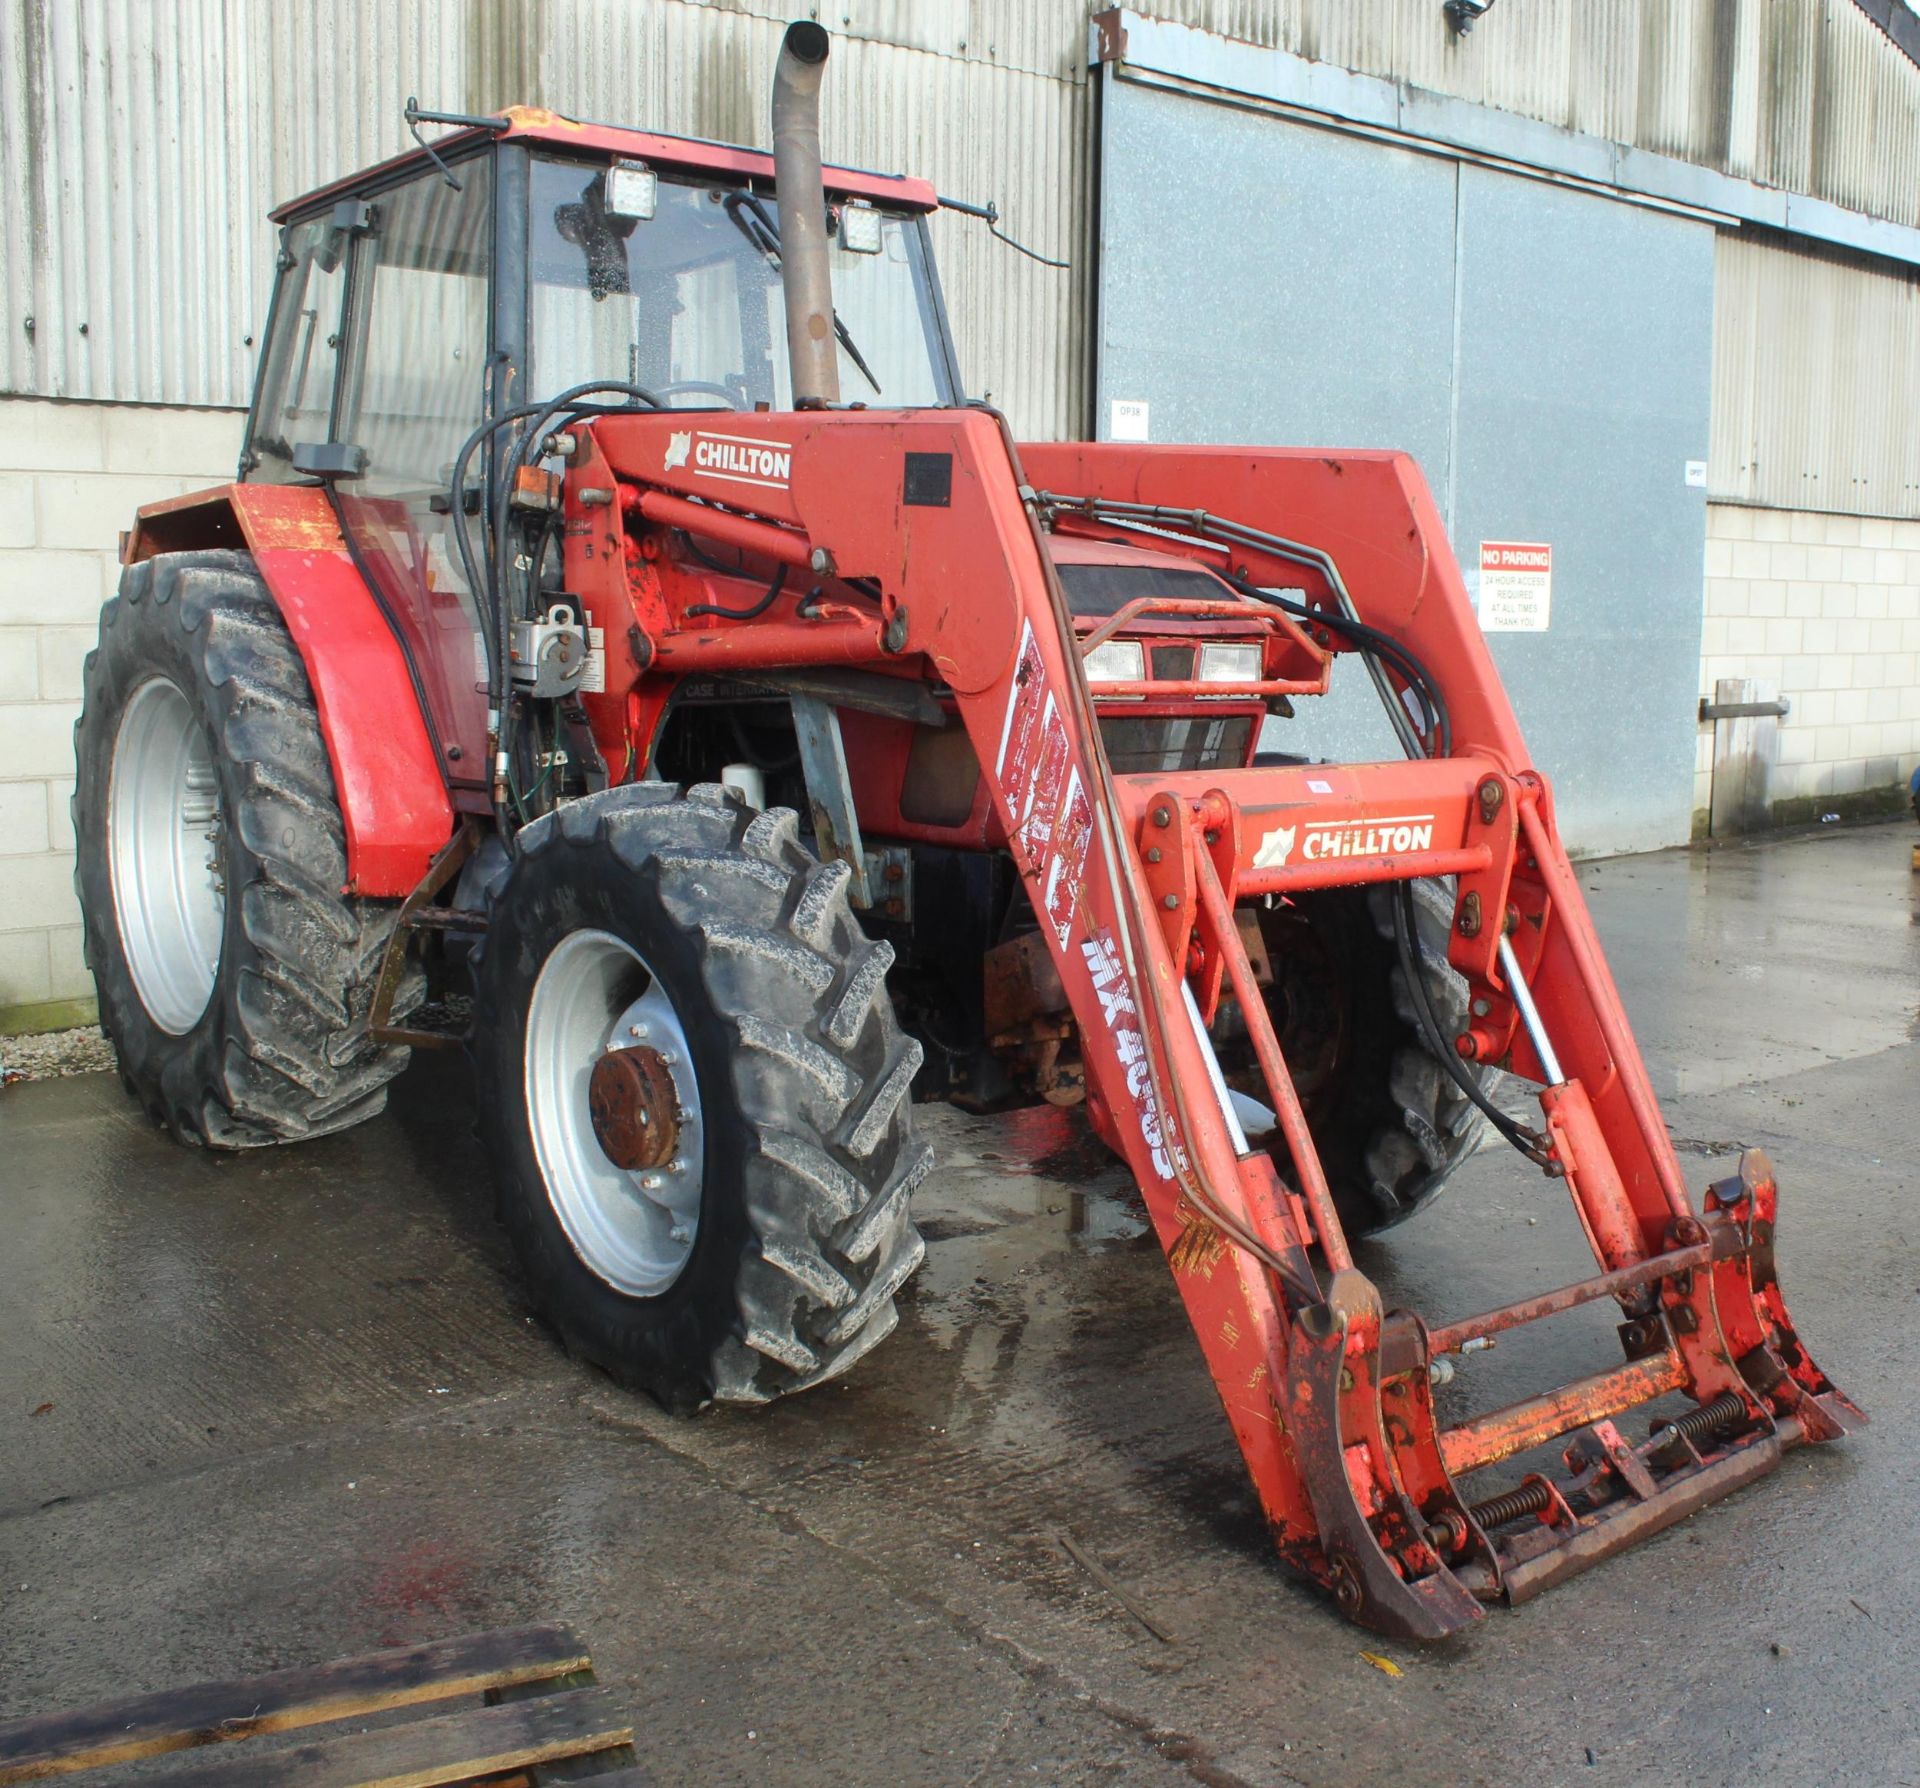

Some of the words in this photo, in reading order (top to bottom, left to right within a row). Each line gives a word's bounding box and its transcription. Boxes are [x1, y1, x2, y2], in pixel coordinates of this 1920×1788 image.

[695, 441, 791, 479] CHILLTON
[1483, 550, 1500, 565] NO
[1502, 550, 1548, 567] PARKING
[1485, 576, 1494, 585] 24
[1495, 576, 1516, 586] HOUR
[1517, 576, 1545, 587] ACCESS
[1497, 590, 1534, 600] REQUIRED
[1491, 604, 1501, 612] AT
[1502, 604, 1515, 613] ALL
[1517, 604, 1537, 614] TIMES
[1494, 617, 1518, 626] THANK
[1520, 617, 1535, 627] YOU
[686, 683, 715, 697] CASE
[1303, 825, 1432, 859] CHILLTON
[1081, 936, 1136, 1028] MX
